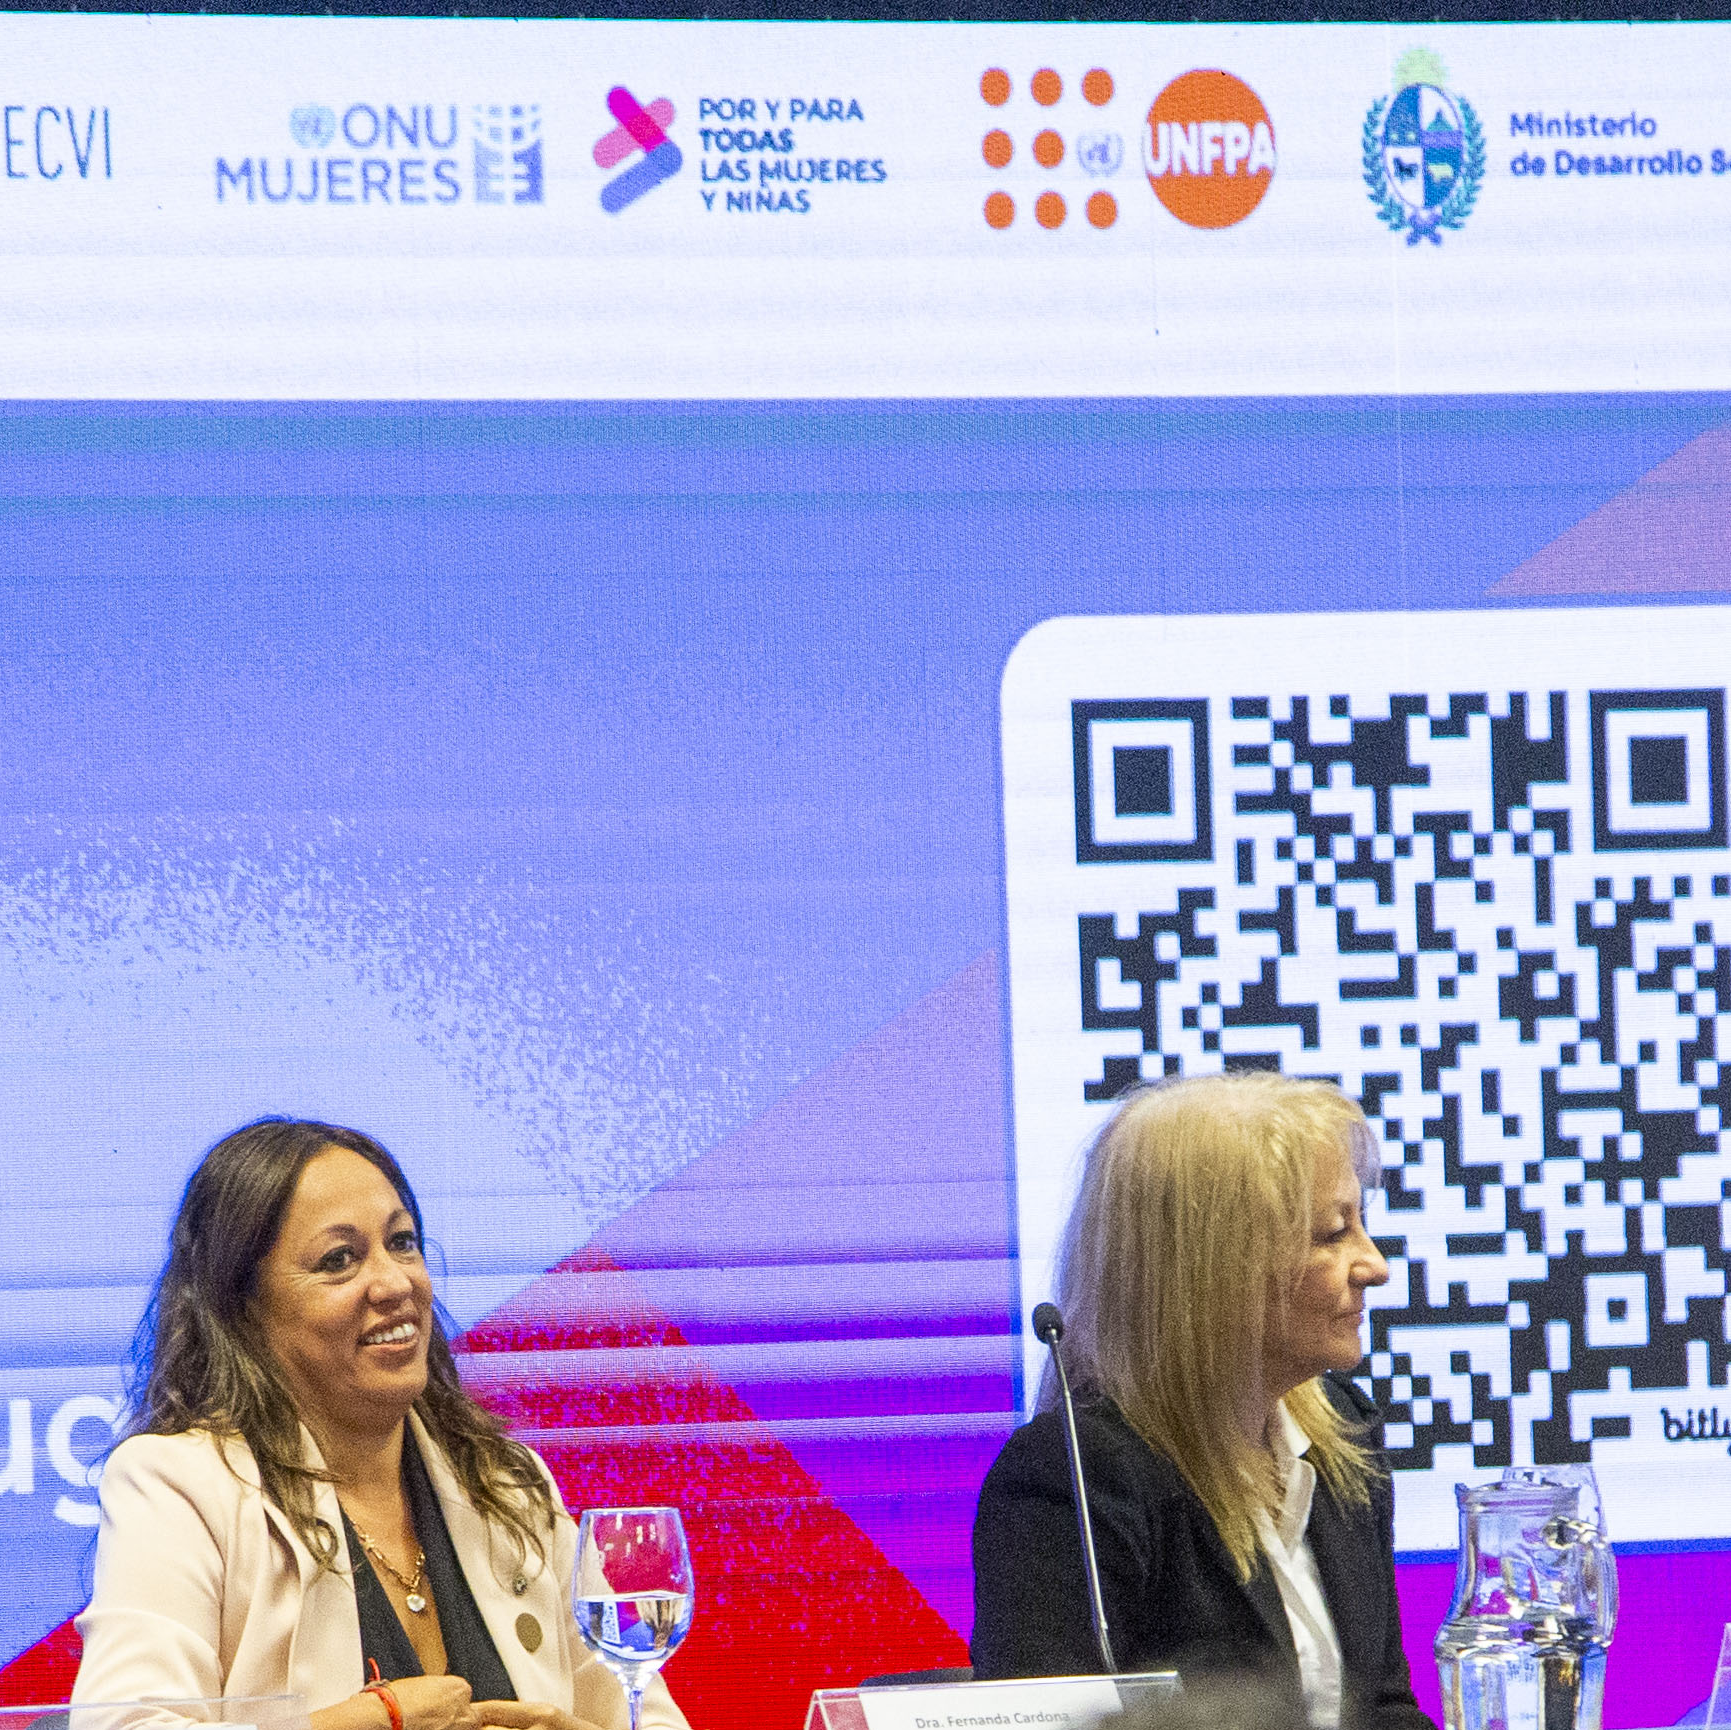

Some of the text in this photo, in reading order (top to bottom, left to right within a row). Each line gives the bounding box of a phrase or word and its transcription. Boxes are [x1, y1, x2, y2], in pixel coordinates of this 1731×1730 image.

[699, 97, 865, 122] POR Y PARA
[1509, 109, 1657, 137] Ministerio
[341, 103, 458, 150] ONU
[698, 127, 794, 153] TODAS
[1143, 121, 1276, 178] UNFPA
[1509, 150, 1547, 176] de
[1554, 149, 1704, 176] Desarrollo
[215, 156, 462, 204] MUJERES
[700, 158, 888, 183] LAS MUJERES
[700, 182, 811, 213] Y NIÑAS
[914, 1711, 1071, 1730] Dra. Fernanda Cardona
